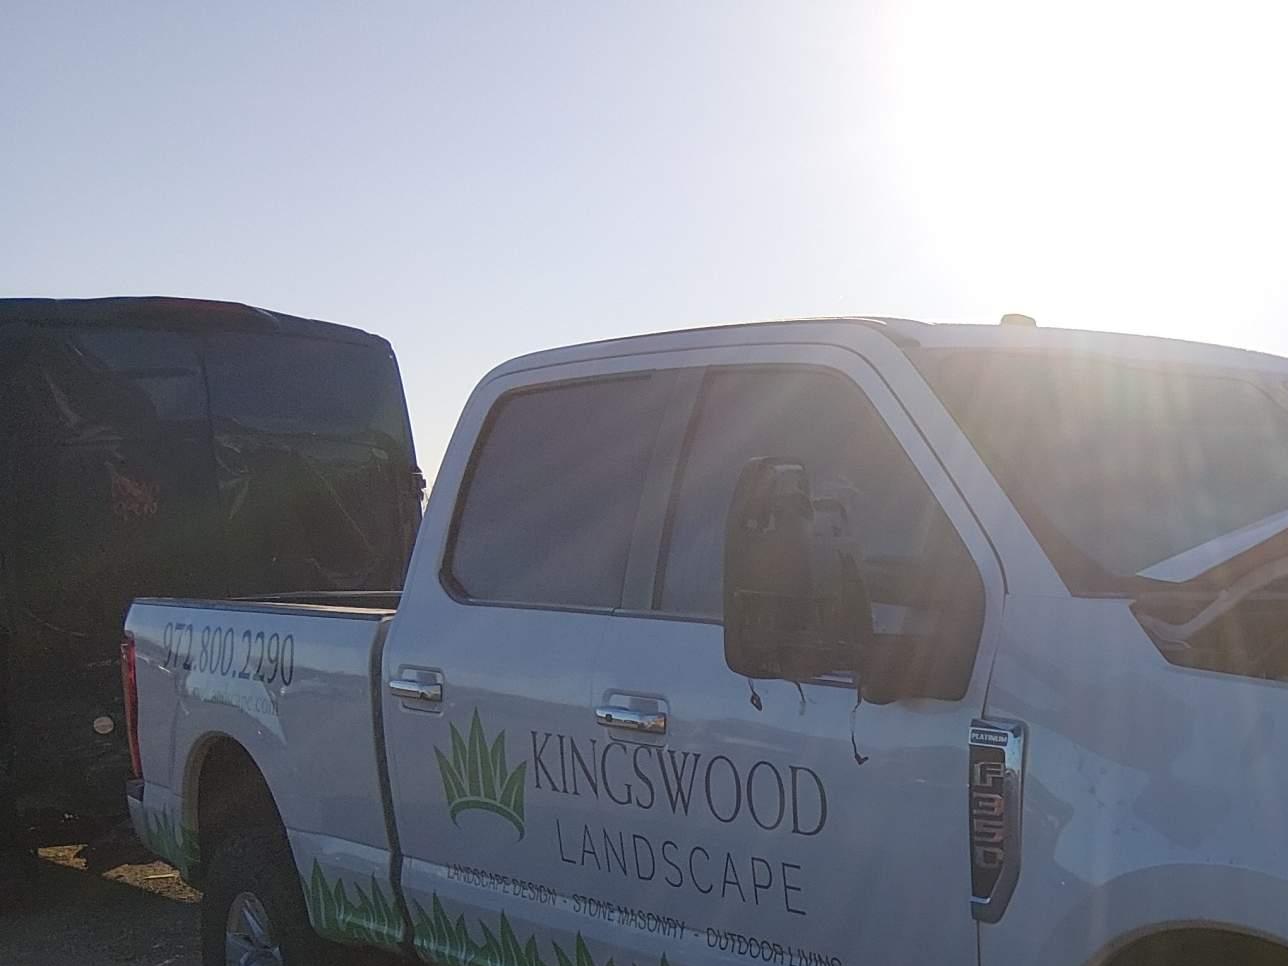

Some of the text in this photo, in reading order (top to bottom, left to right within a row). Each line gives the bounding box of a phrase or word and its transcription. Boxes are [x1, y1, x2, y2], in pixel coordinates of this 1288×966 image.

[163, 622, 294, 687] 972.800.2290
[530, 730, 829, 837] KINGSWOOD
[972, 732, 1007, 742] PLATINUM
[446, 862, 512, 895] LANDSCAPE
[512, 877, 558, 906] DESIGN
[572, 894, 616, 923] STONE
[617, 906, 688, 941] MASONRY
[706, 926, 785, 966] OUTDOOR
[555, 817, 809, 916] LANDSCAPE
